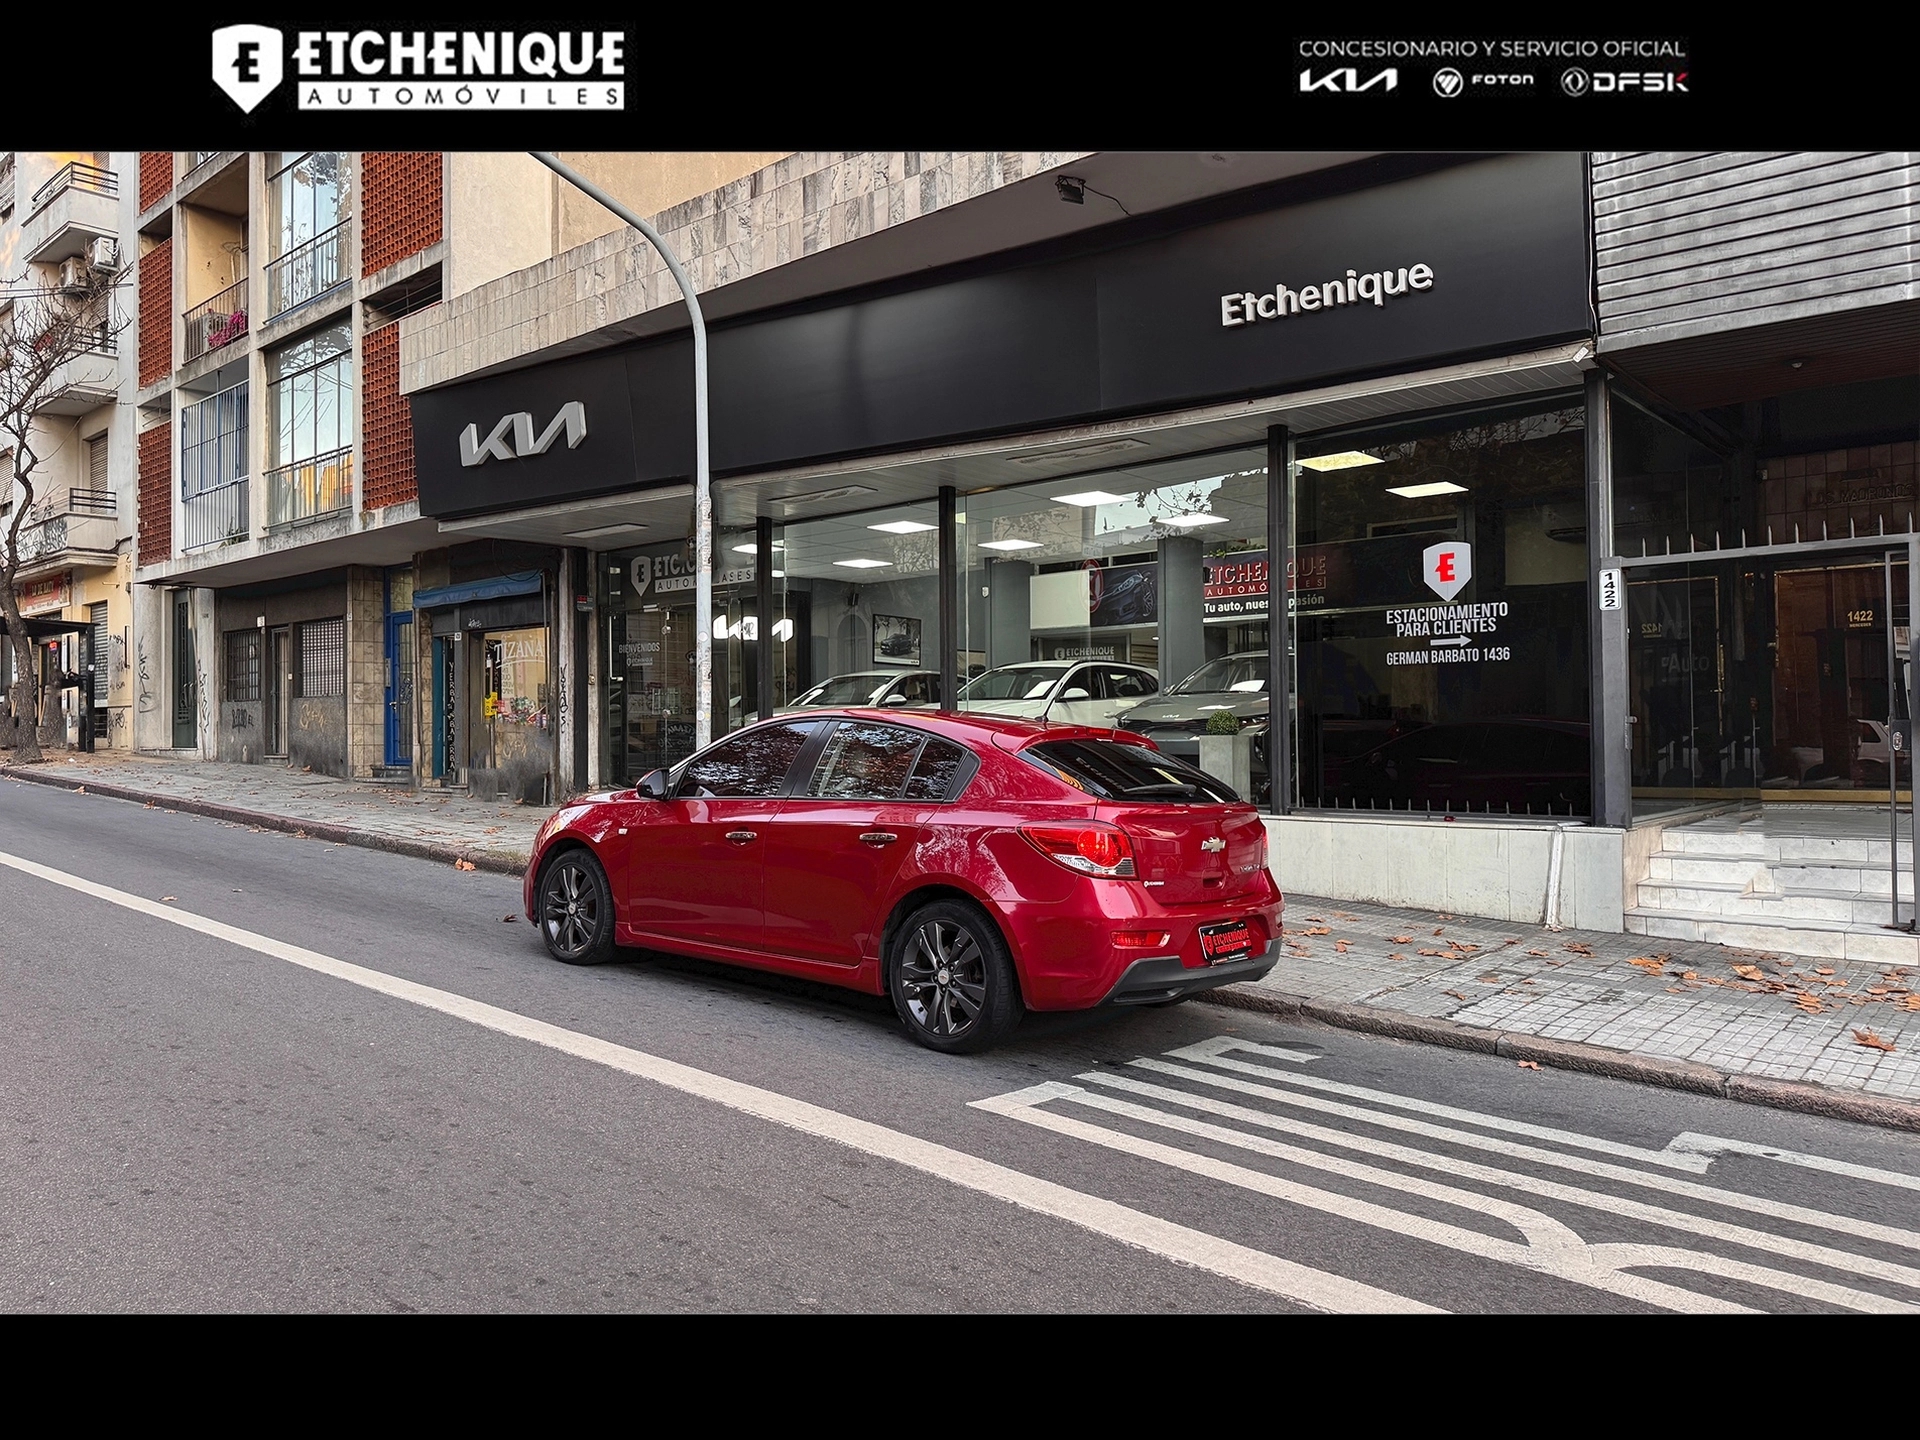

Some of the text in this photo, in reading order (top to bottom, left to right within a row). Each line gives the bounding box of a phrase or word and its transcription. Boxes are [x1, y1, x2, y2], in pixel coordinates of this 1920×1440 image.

[1221, 263, 1434, 327] Etchenique
[459, 401, 587, 467] KIA
[1604, 572, 1616, 607] 1422
[1204, 603, 1216, 613] Tu
[1218, 602, 1244, 612] auto,
[1288, 593, 1325, 609] pasión
[1386, 601, 1508, 624] ESTACIONAMIENTO
[1847, 610, 1873, 622] 1422
[1396, 617, 1496, 637] PARA CLIENTES
[494, 640, 545, 664] TIZANA
[1066, 646, 1114, 657] ETCHENIQUE
[1386, 646, 1510, 665] GERMAN BARBATO 1436
